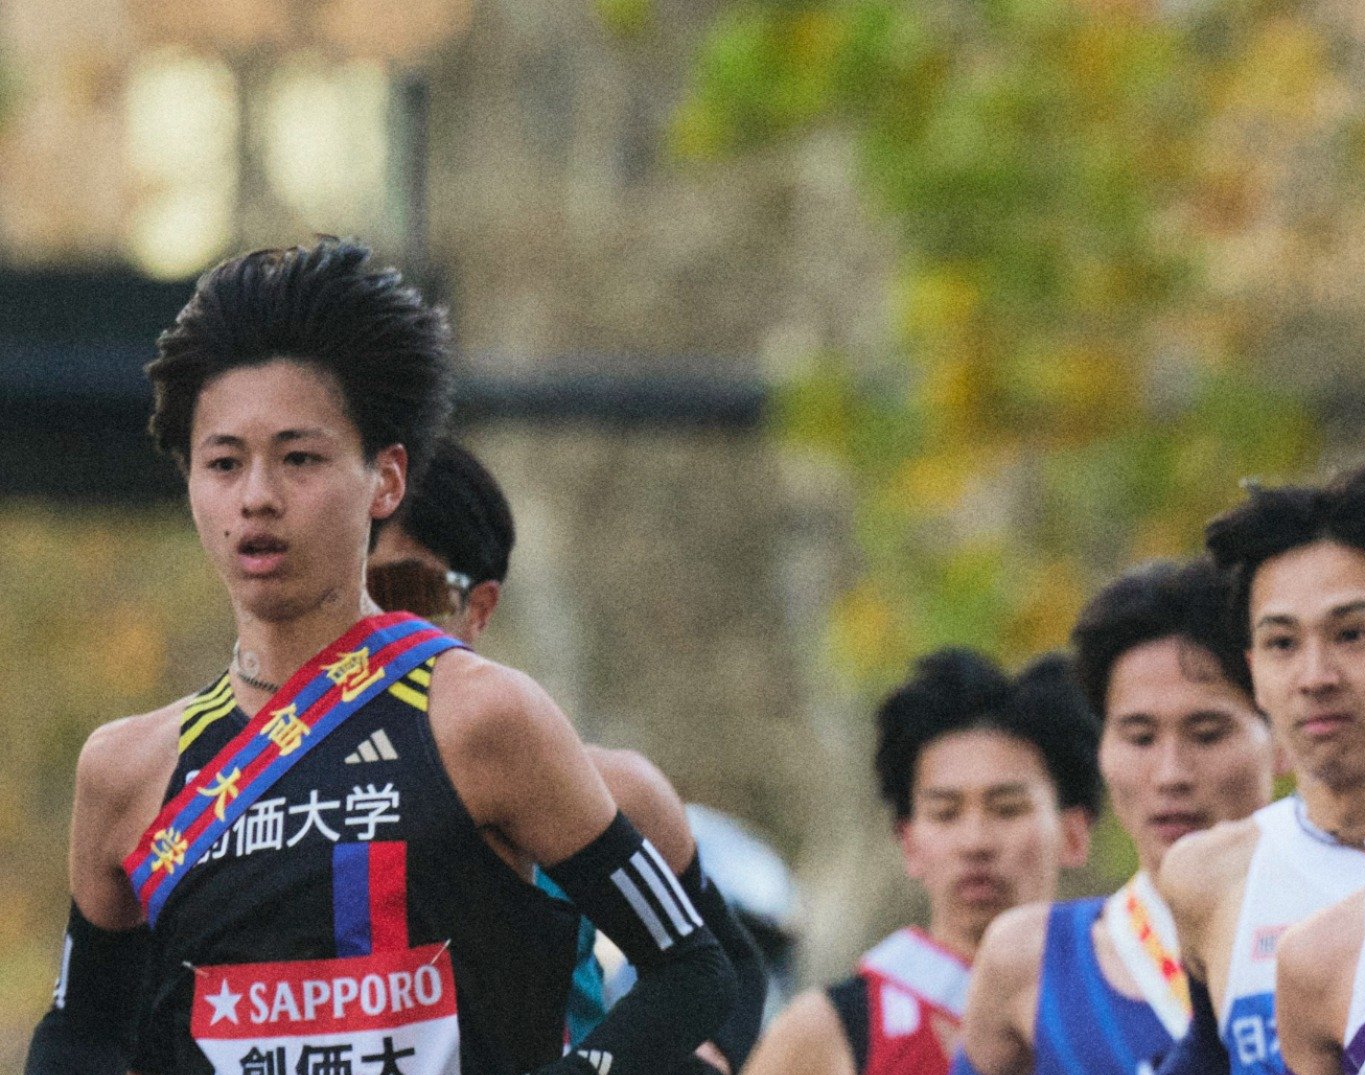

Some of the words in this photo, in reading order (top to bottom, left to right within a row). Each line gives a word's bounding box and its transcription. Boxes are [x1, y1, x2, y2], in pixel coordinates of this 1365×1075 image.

[150, 646, 386, 876] 創価大学
[250, 965, 443, 1025] SAPPORO
